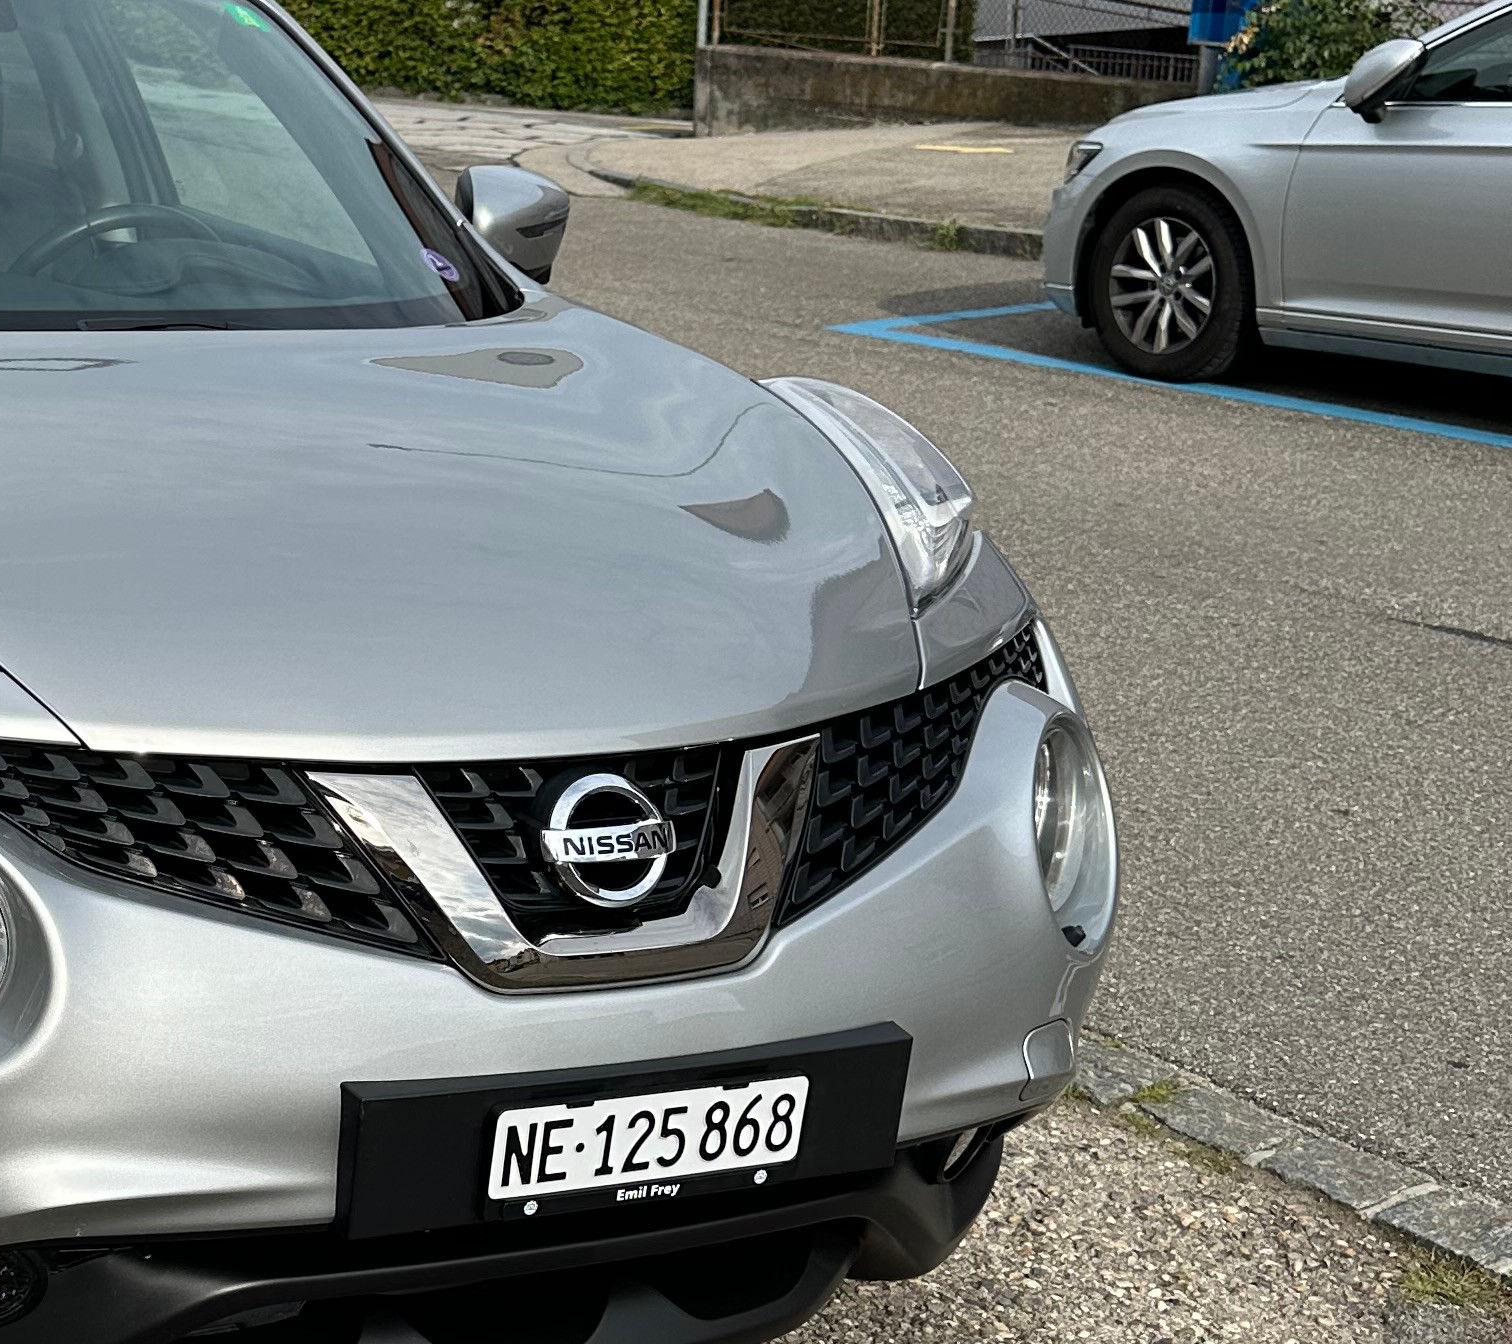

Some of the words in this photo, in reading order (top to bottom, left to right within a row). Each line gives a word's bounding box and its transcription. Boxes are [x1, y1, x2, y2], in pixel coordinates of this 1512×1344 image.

[562, 827, 668, 856] NISSAN
[616, 1185, 647, 1202] Emil
[650, 1183, 681, 1199] Frey
